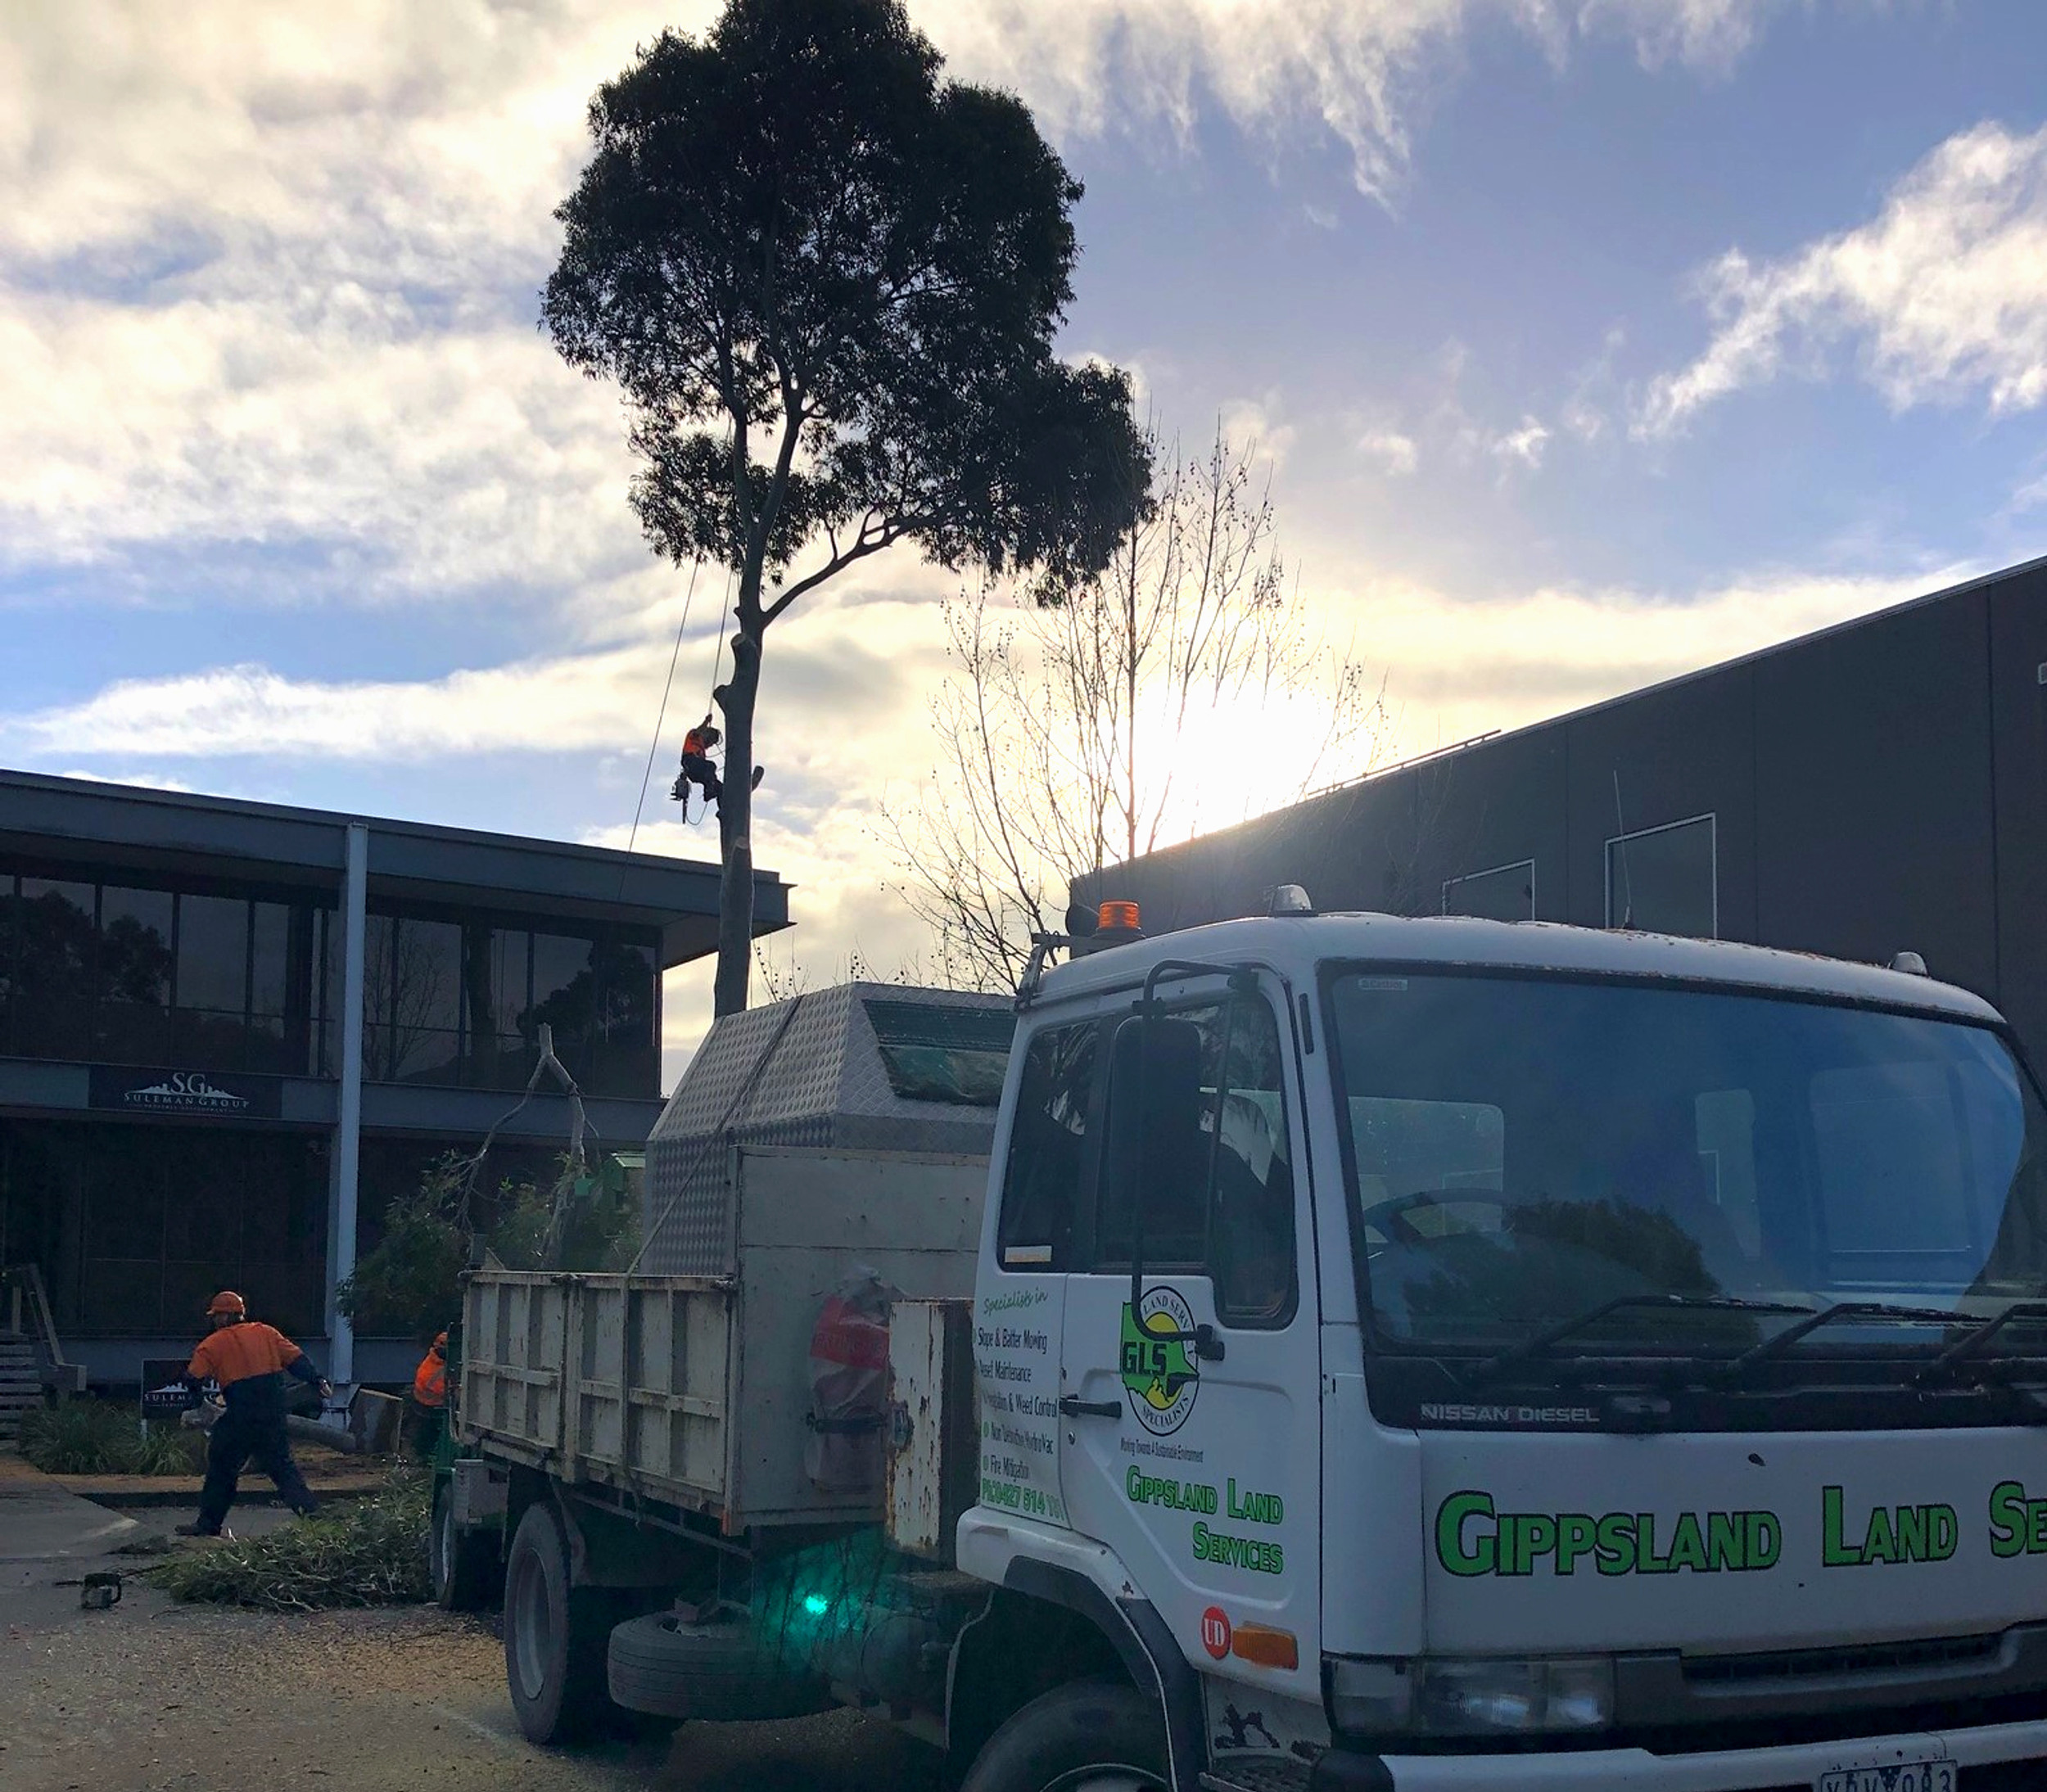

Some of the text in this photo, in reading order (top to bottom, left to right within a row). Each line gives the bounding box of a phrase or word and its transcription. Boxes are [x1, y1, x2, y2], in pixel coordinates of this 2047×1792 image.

[170, 1072, 205, 1095] SG
[124, 1093, 250, 1108] SULEMAN GROUP
[1035, 1286, 1049, 1303] in
[995, 1327, 1001, 1347] &
[1123, 1342, 1167, 1376] GLS
[143, 1393, 194, 1402] SULEM
[1009, 1393, 1014, 1412] &
[1015, 1393, 1033, 1415] Weed
[1034, 1396, 1058, 1418] Control
[1141, 1394, 1189, 1427] SPECIALISTS
[1421, 1404, 1599, 1423] NISSAN DIESEL
[1126, 1465, 1284, 1525] GIPPSLAND LAND
[1435, 1489, 1783, 1576] GIPPSLAND
[1822, 1484, 1959, 1568] LAND
[1192, 1522, 1284, 1575] SERVICES
[1204, 1618, 1225, 1646] UD
